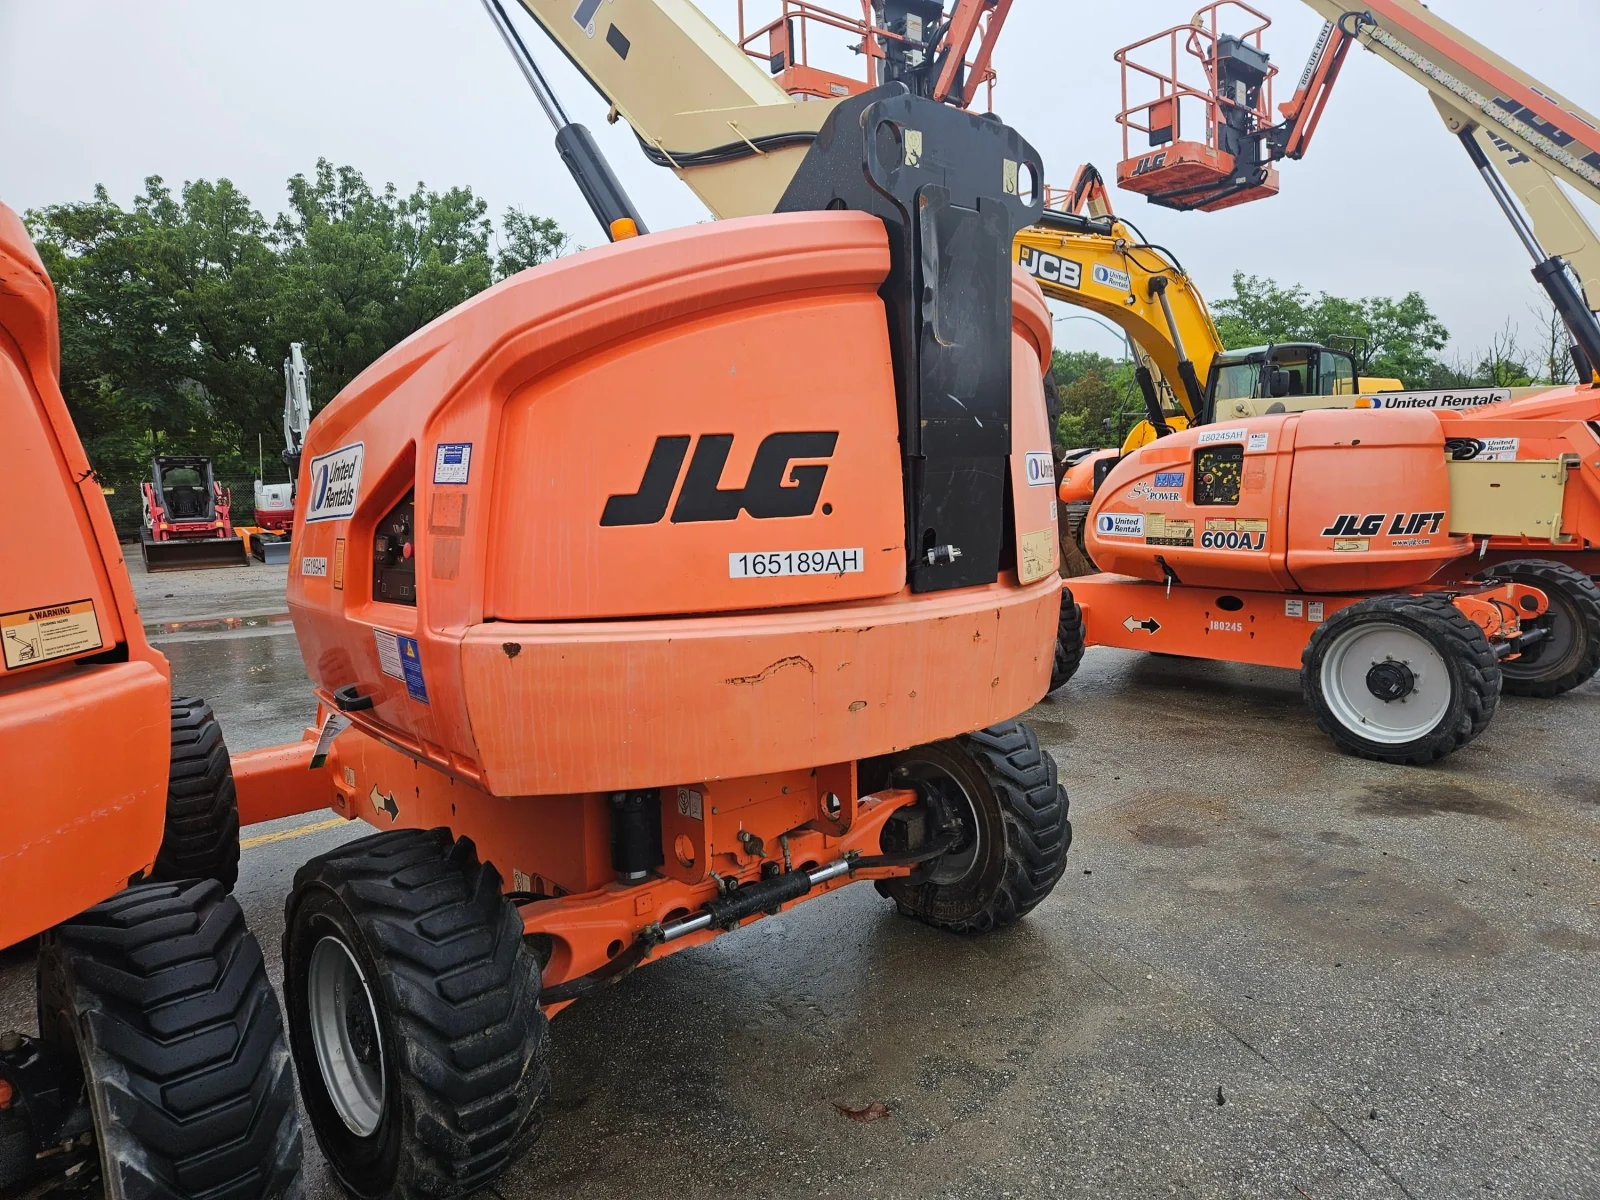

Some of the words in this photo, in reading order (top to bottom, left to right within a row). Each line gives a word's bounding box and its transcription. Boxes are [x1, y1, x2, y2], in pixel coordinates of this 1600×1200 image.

[1131, 151, 1167, 177] JLG
[1020, 250, 1081, 288] JCB
[1108, 277, 1129, 289] Rentals
[1109, 271, 1130, 282] United
[1384, 396, 1438, 409] United
[1440, 393, 1503, 407] Rentals
[1486, 444, 1516, 452] Rentals
[328, 455, 358, 484] United
[323, 482, 355, 509] Rentals
[1149, 491, 1180, 501] POWER
[1114, 517, 1139, 526] United
[1321, 513, 1386, 537] JLG
[1386, 511, 1446, 536] LIFT
[1114, 524, 1141, 534] Rentals
[1201, 531, 1266, 550] 600AJ
[739, 550, 858, 576] 165189AH
[35, 606, 71, 620] WARNING
[1210, 620, 1243, 632] 180245
